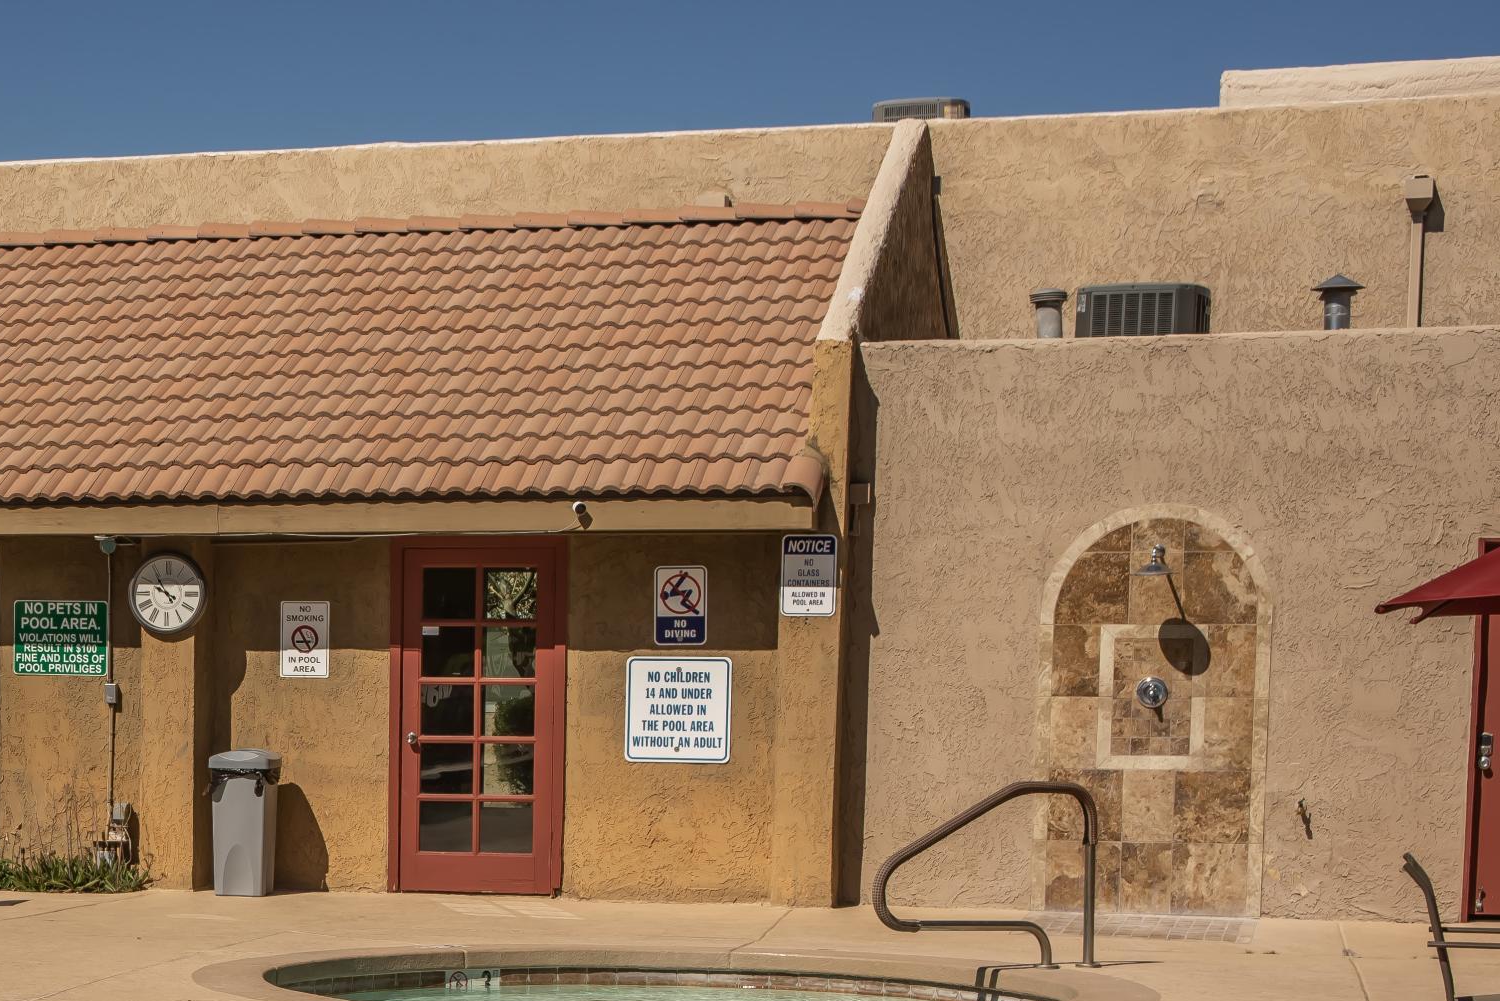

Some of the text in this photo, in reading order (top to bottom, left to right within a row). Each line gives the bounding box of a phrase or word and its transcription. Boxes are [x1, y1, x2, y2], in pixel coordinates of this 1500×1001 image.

[788, 540, 831, 553] NOTICE
[804, 558, 814, 566] NO
[798, 568, 820, 576] GLASS
[787, 579, 830, 587] CONTAINERS
[24, 602, 98, 615] NO PETS IN
[20, 617, 100, 630] POOL AREA.
[18, 632, 102, 644] VIOLATIONS WILL
[664, 630, 697, 638] DIVING
[24, 644, 98, 654] RESULT IN $100
[16, 653, 105, 664] FINE AND LOSS OF
[18, 663, 102, 674] POOL PRIVILIGES
[648, 672, 710, 683] NO CHILDREN
[646, 688, 712, 700] 14 AND UNDER
[650, 704, 706, 716] ALLOWED IN
[642, 720, 714, 732] THE POOL AREA
[632, 736, 722, 748] WITHOUT AN ADULT
